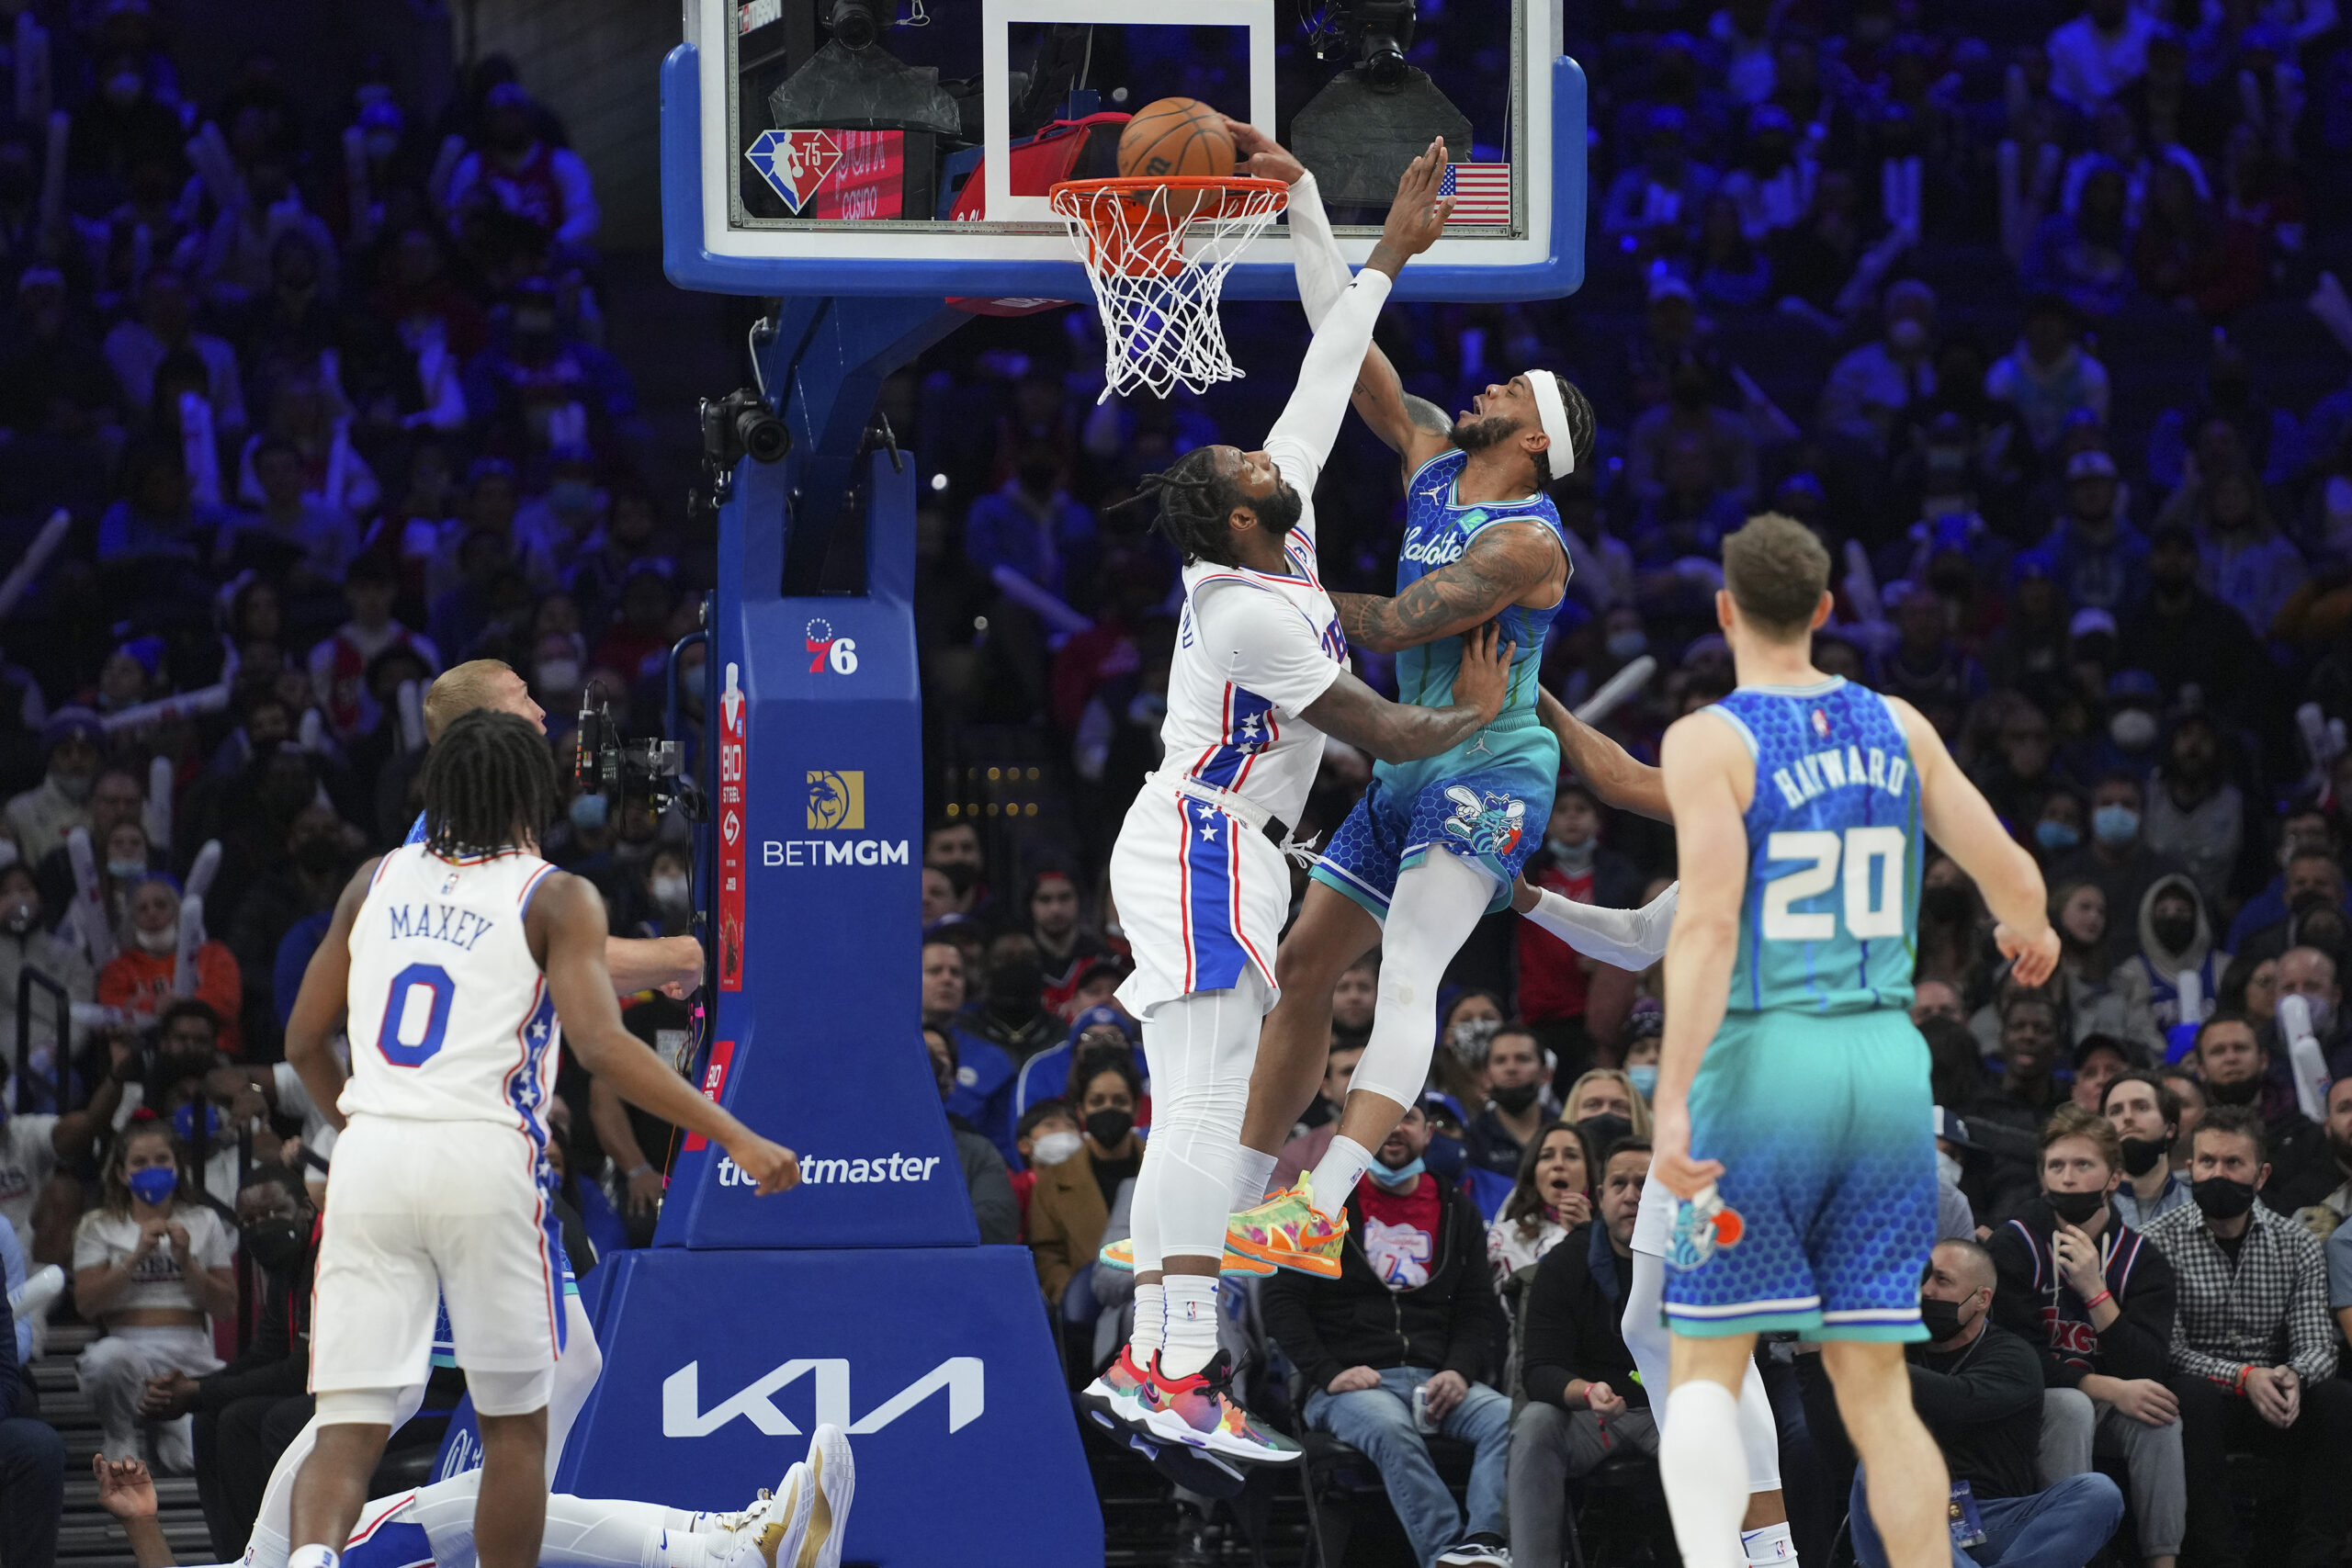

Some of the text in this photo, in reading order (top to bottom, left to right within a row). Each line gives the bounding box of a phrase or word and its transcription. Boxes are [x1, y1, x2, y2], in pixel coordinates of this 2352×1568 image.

[802, 142, 821, 166] 75
[842, 185, 878, 220] casino
[805, 637, 858, 675] 76
[722, 744, 742, 782] BIO
[1772, 745, 1911, 810] HAYWARD
[722, 785, 741, 804] STEEL
[763, 839, 910, 867] BETMGM
[1761, 825, 1907, 942] 20
[390, 903, 495, 952] MAXEY
[377, 962, 456, 1068] 0
